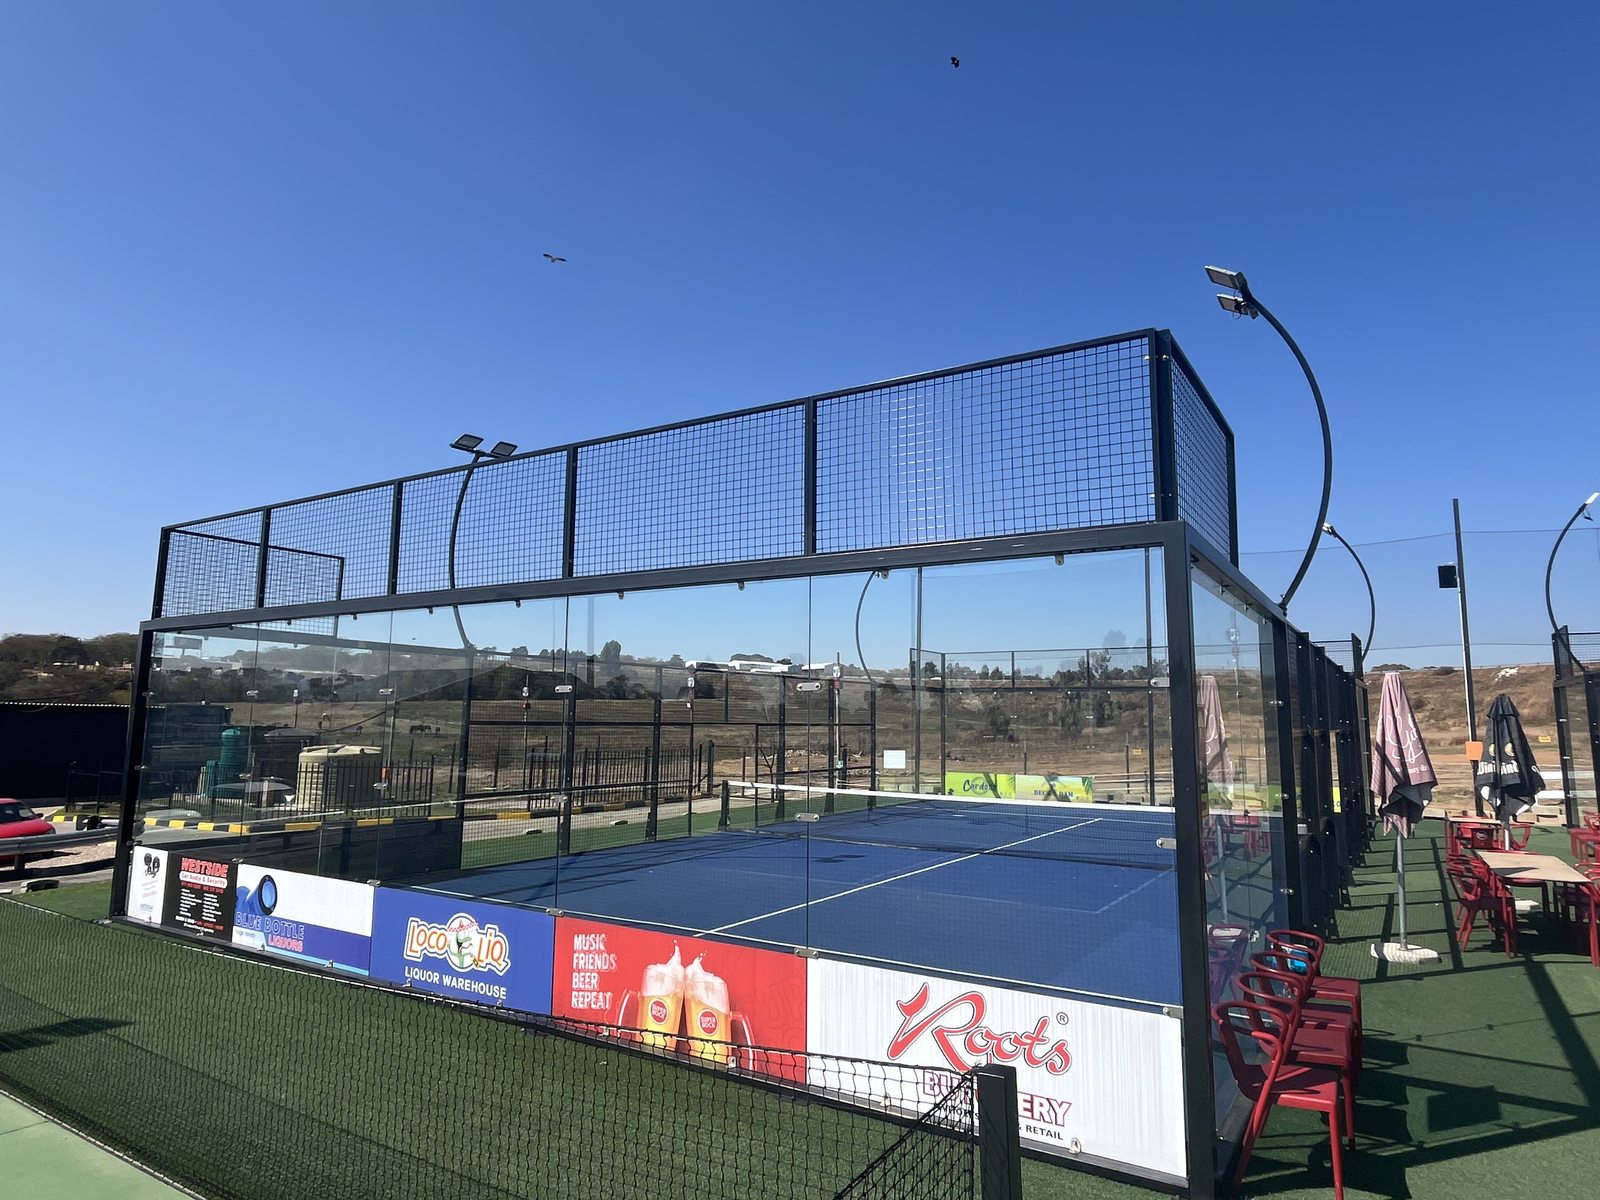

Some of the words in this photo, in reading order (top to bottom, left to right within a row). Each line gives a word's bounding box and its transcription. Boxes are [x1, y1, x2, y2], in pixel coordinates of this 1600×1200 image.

[181, 857, 229, 877] WESTSIDE
[207, 877, 226, 887] Security
[235, 911, 261, 930] BLUE
[264, 917, 305, 940] BOTTLE
[268, 933, 304, 952] LIQUORS
[573, 933, 607, 951] MUSIC
[572, 952, 617, 971] FRIENDS
[405, 966, 440, 985] LIQUOR
[442, 974, 507, 999] WAREHOUSE
[572, 972, 599, 990] BEER
[571, 991, 613, 1009] REPEAT
[888, 982, 1072, 1076] Roots
[1025, 1124, 1064, 1141] RETAIL
